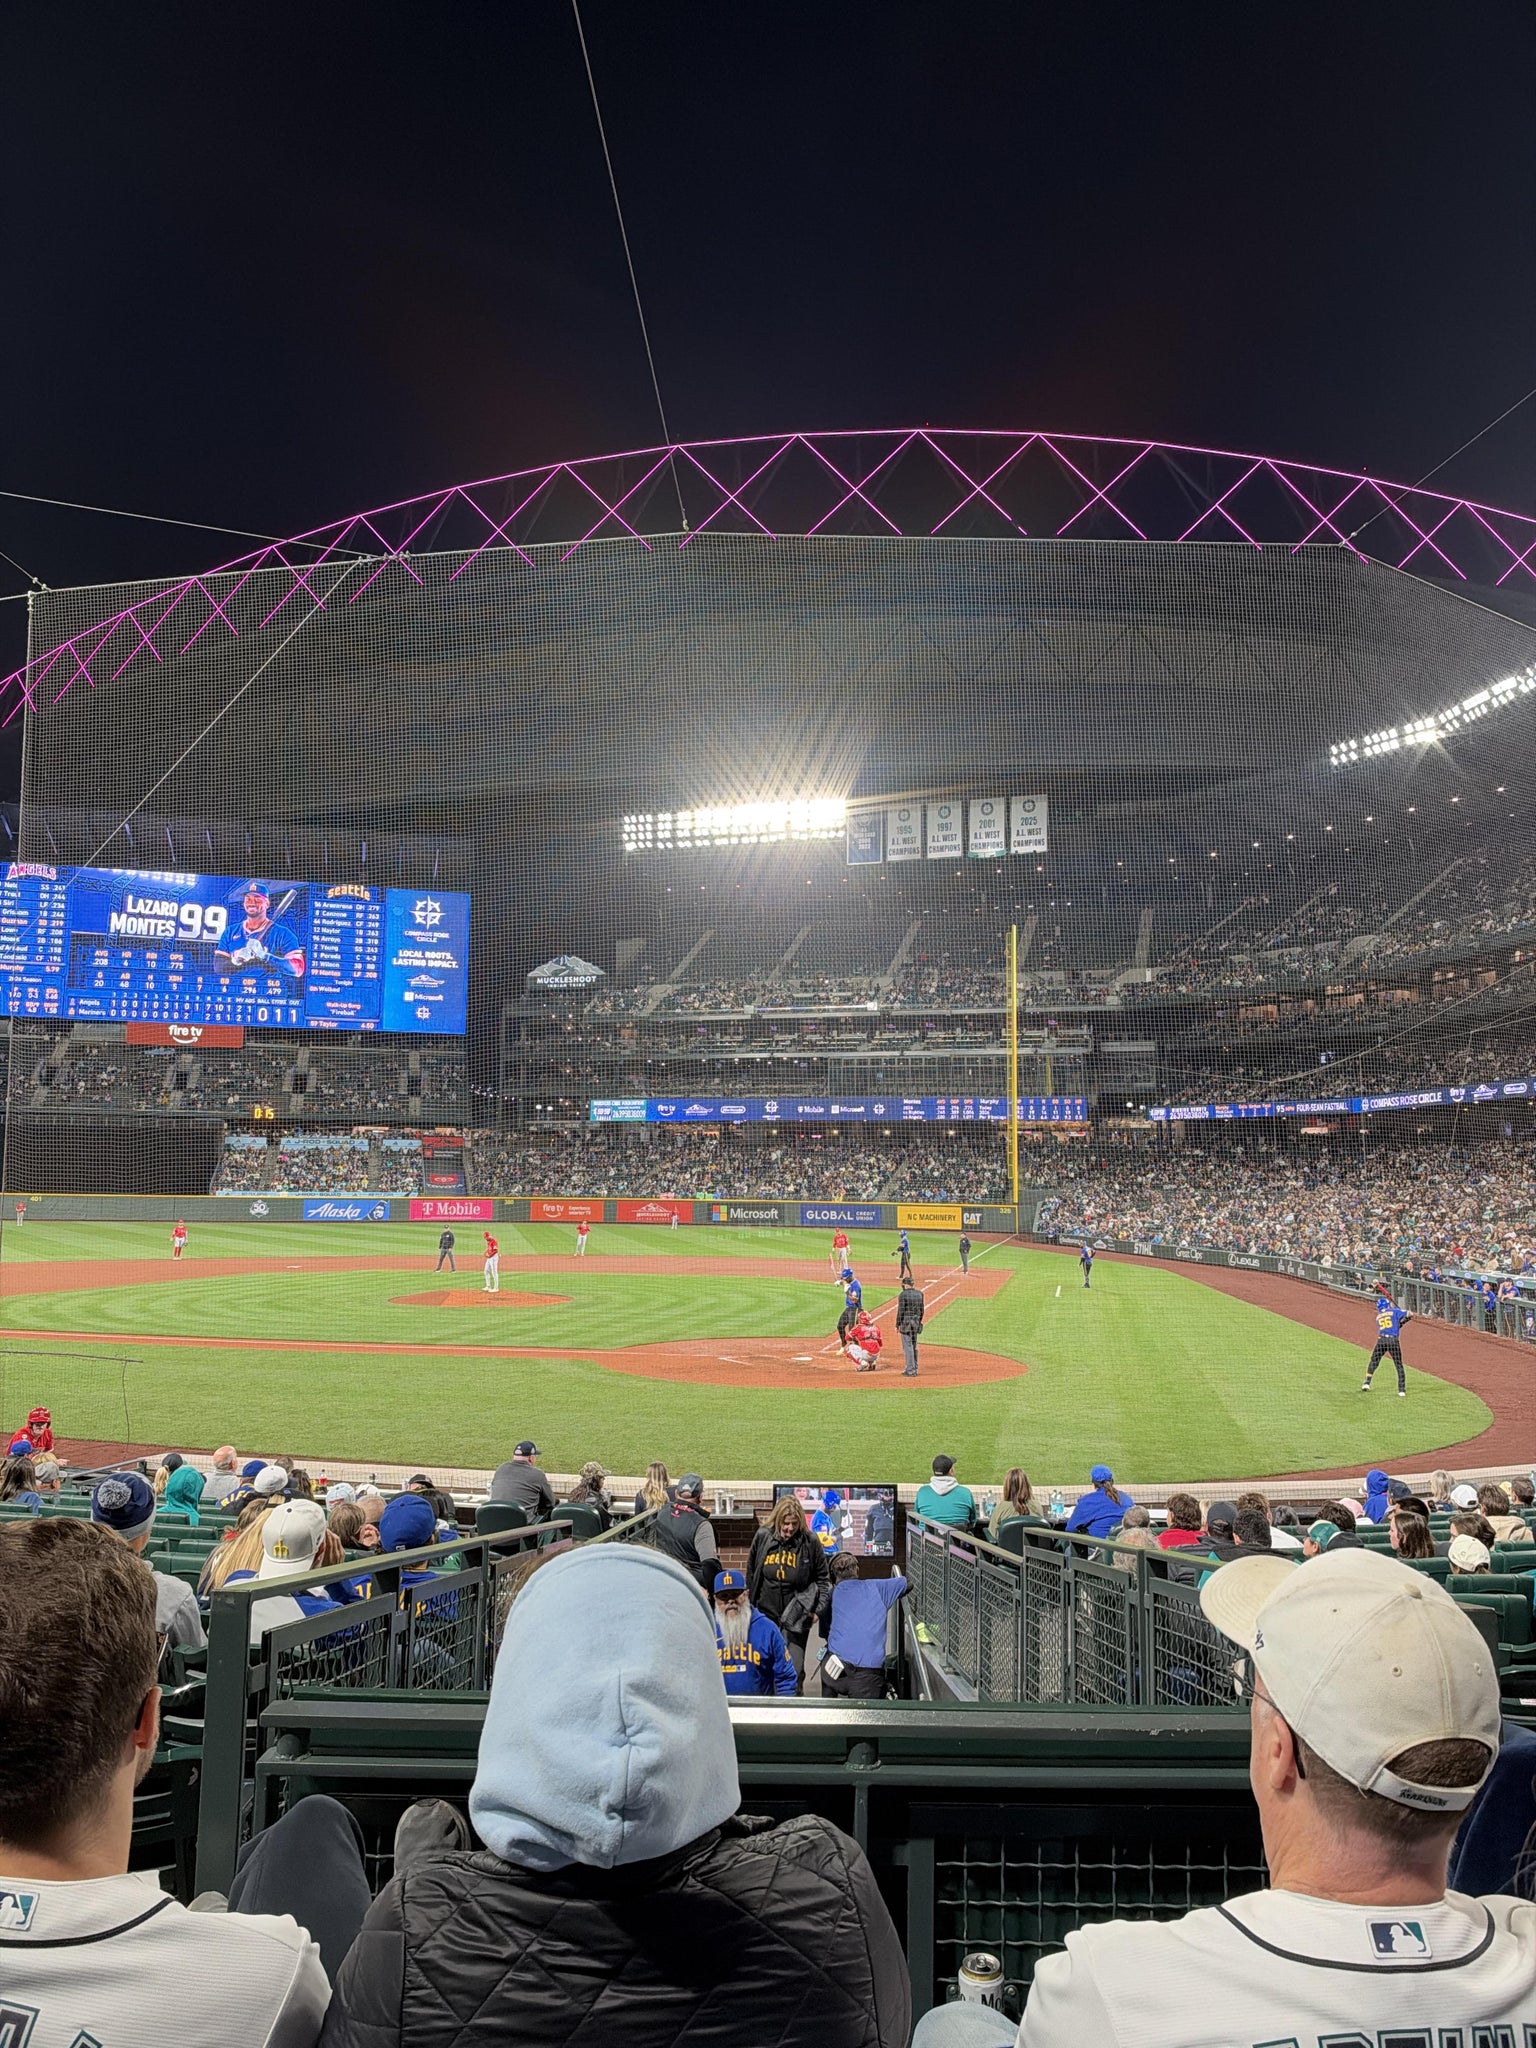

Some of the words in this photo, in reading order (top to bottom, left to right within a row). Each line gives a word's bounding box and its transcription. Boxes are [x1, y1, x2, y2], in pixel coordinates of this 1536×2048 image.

[979, 819, 996, 828] 2001
[1021, 816, 1038, 826] 2025
[985, 831, 1000, 839] WEST
[1027, 828, 1042, 836] WEST
[929, 844, 960, 853] CHAMPIONS
[971, 842, 1004, 850] CHAMPIONS
[1013, 839, 1045, 848] CHAMPIONS
[6, 862, 56, 880] ANGELS
[328, 884, 370, 901] seattle
[126, 895, 178, 917] LAZARO
[110, 912, 176, 936] MONTES
[178, 903, 228, 940] 99
[400, 950, 424, 958] LOCAL
[425, 952, 453, 960] ROOTS.
[392, 958, 426, 966] LASTING
[428, 960, 458, 968] IMPACT.
[258, 1008, 268, 1021] 0
[276, 1008, 281, 1022] 1
[290, 1010, 296, 1023] 1
[168, 1025, 190, 1036] fire
[190, 1026, 202, 1036] tv
[1370, 1096, 1399, 1108] COMPASS
[1400, 1094, 1418, 1106] ROSE
[1418, 1092, 1442, 1104] CIRCLE
[1276, 1104, 1284, 1112] 95
[1324, 1102, 1348, 1112] FASTBALL
[308, 1202, 362, 1218] Alaska
[436, 1202, 480, 1215] Mobile
[542, 1204, 556, 1212] fire
[730, 1208, 778, 1219] Microsoft
[806, 1210, 853, 1220] GLOBAL
[919, 1214, 956, 1222] MACHINERY
[964, 1212, 982, 1224] CAT
[1134, 1242, 1153, 1256] STIHL
[1176, 1248, 1190, 1260] Great
[1236, 1255, 1260, 1268] LEXUS
[1378, 1316, 1393, 1330] 56
[764, 1550, 796, 1568] seattl
[716, 1642, 761, 1666] eattle
